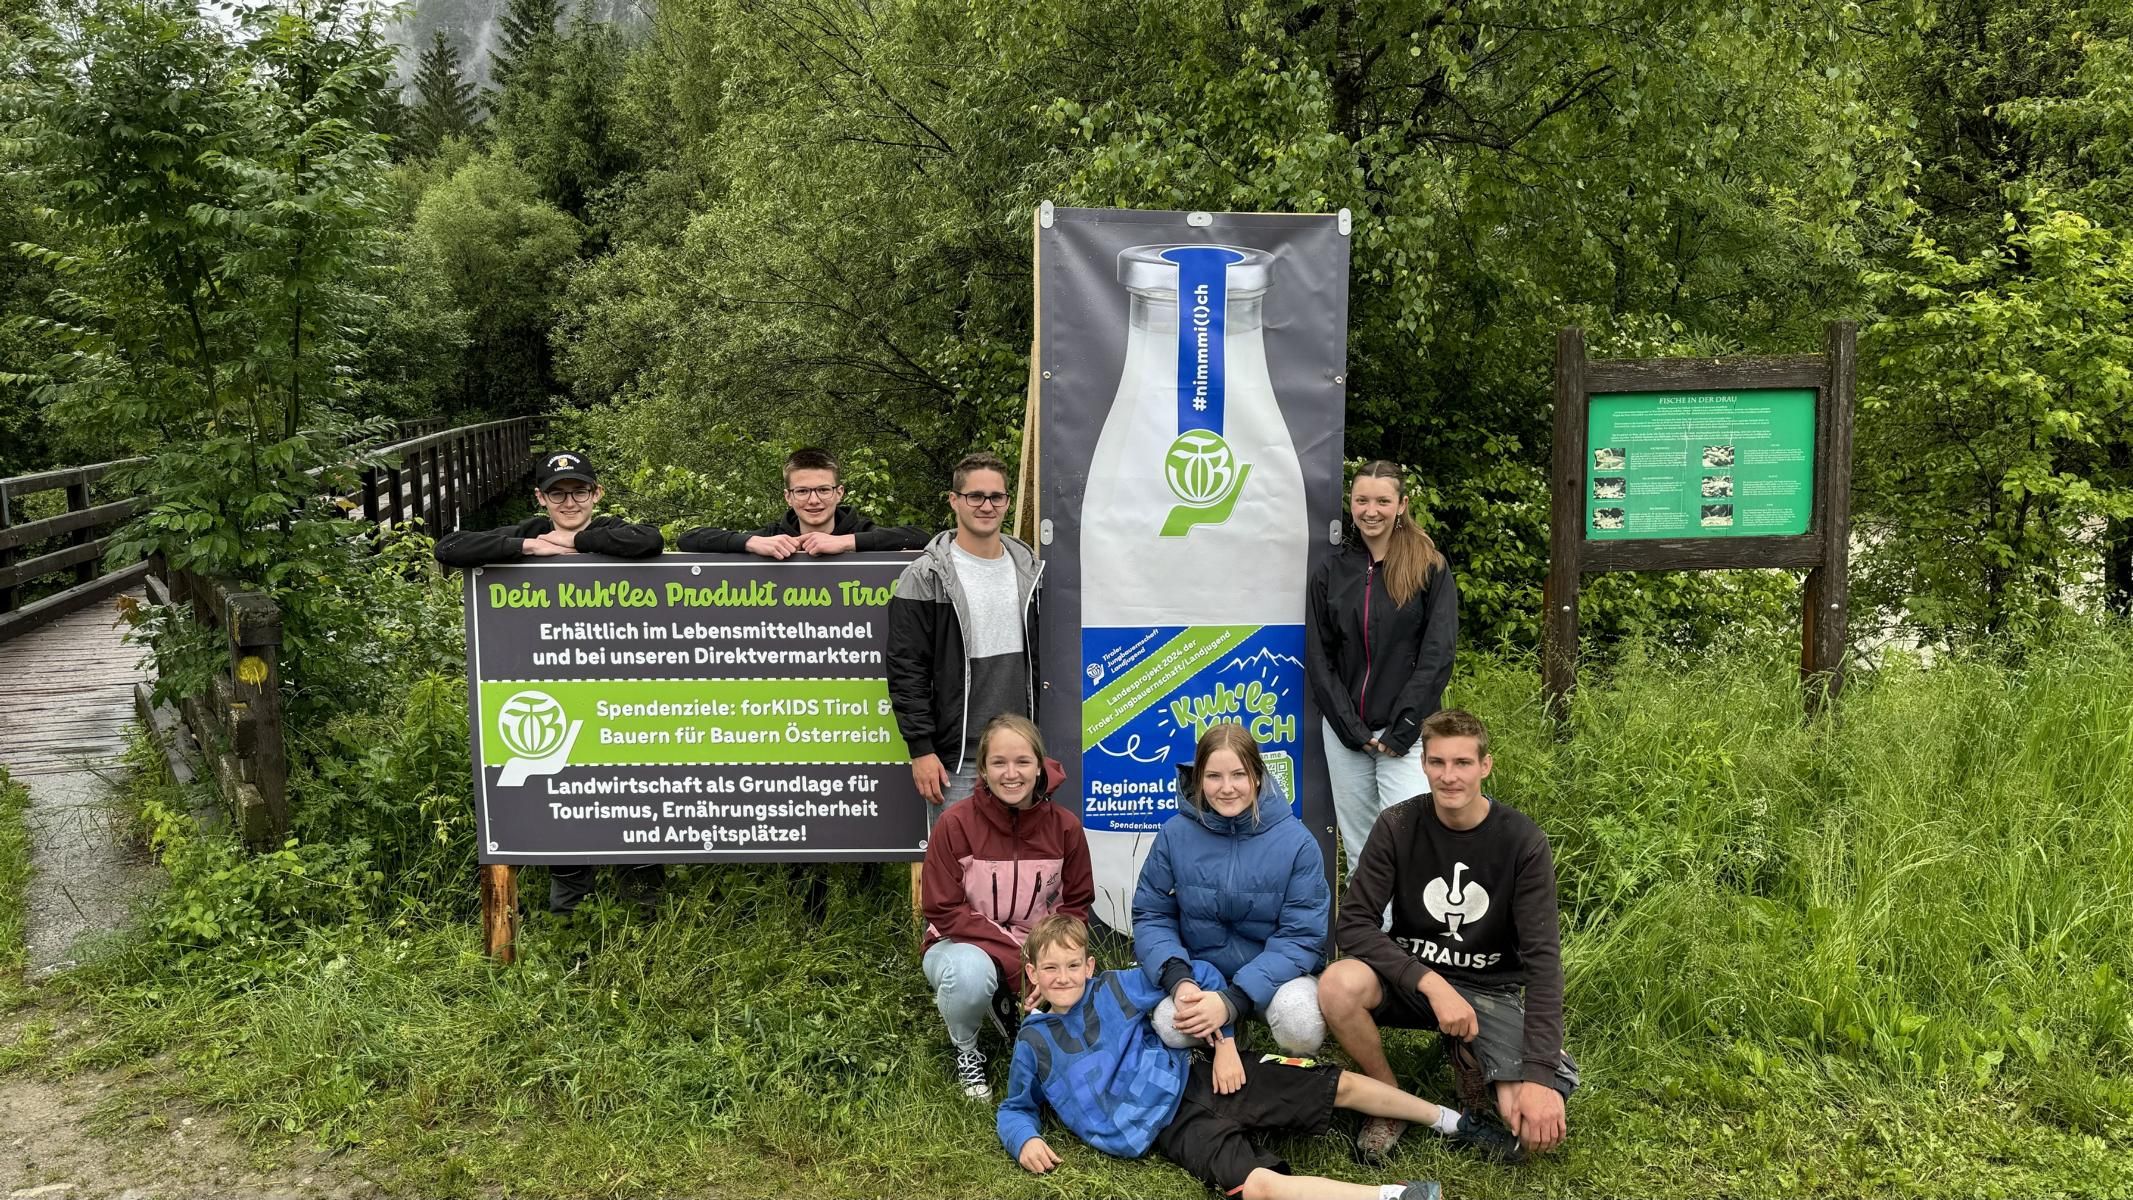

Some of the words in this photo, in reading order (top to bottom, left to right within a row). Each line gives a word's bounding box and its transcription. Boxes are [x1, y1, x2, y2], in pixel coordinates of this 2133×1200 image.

[1192, 284, 1211, 411] #nimmmi(l)ch
[1715, 395, 1738, 403] DRAU
[489, 582, 551, 609] Dein
[665, 579, 778, 608] Produkt
[783, 586, 832, 607] aus
[540, 622, 639, 640] Erhältlich
[643, 621, 667, 640] im
[671, 621, 873, 640] Lebensmittelhandel
[533, 648, 571, 665] und
[575, 647, 606, 665] bei
[610, 650, 690, 665] unseren
[694, 646, 882, 665] Direktvermarktern
[1102, 645, 1123, 662] Tiroler
[1107, 628, 1160, 668] Jungbauernschaft
[1110, 647, 1146, 674] Landjugend
[1106, 663, 1165, 707] Landesprojekt
[1161, 649, 1184, 669] 2024
[1183, 638, 1198, 653] der
[596, 699, 736, 721] Spendenziele:
[741, 699, 820, 717] forKIDS
[823, 699, 869, 716] Tirol
[877, 699, 893, 716] &
[600, 728, 671, 744] Bauern
[674, 726, 706, 744] für
[710, 727, 781, 744] Bauern
[785, 722, 891, 744] Österreich
[1086, 713, 1115, 735] Tiroler
[547, 776, 703, 795] Landwirtschaft
[706, 776, 736, 794] als
[739, 775, 844, 796] Grundlage
[847, 774, 880, 793] für
[1091, 779, 1164, 798] Regional
[549, 801, 658, 822] Tourismus,
[662, 799, 879, 822] Ernährungssicherheit
[1085, 796, 1154, 812] Zukunft
[623, 826, 661, 843] und
[664, 824, 807, 845] Arbeitsplätze!
[1396, 936, 1502, 969] STRAUSS
